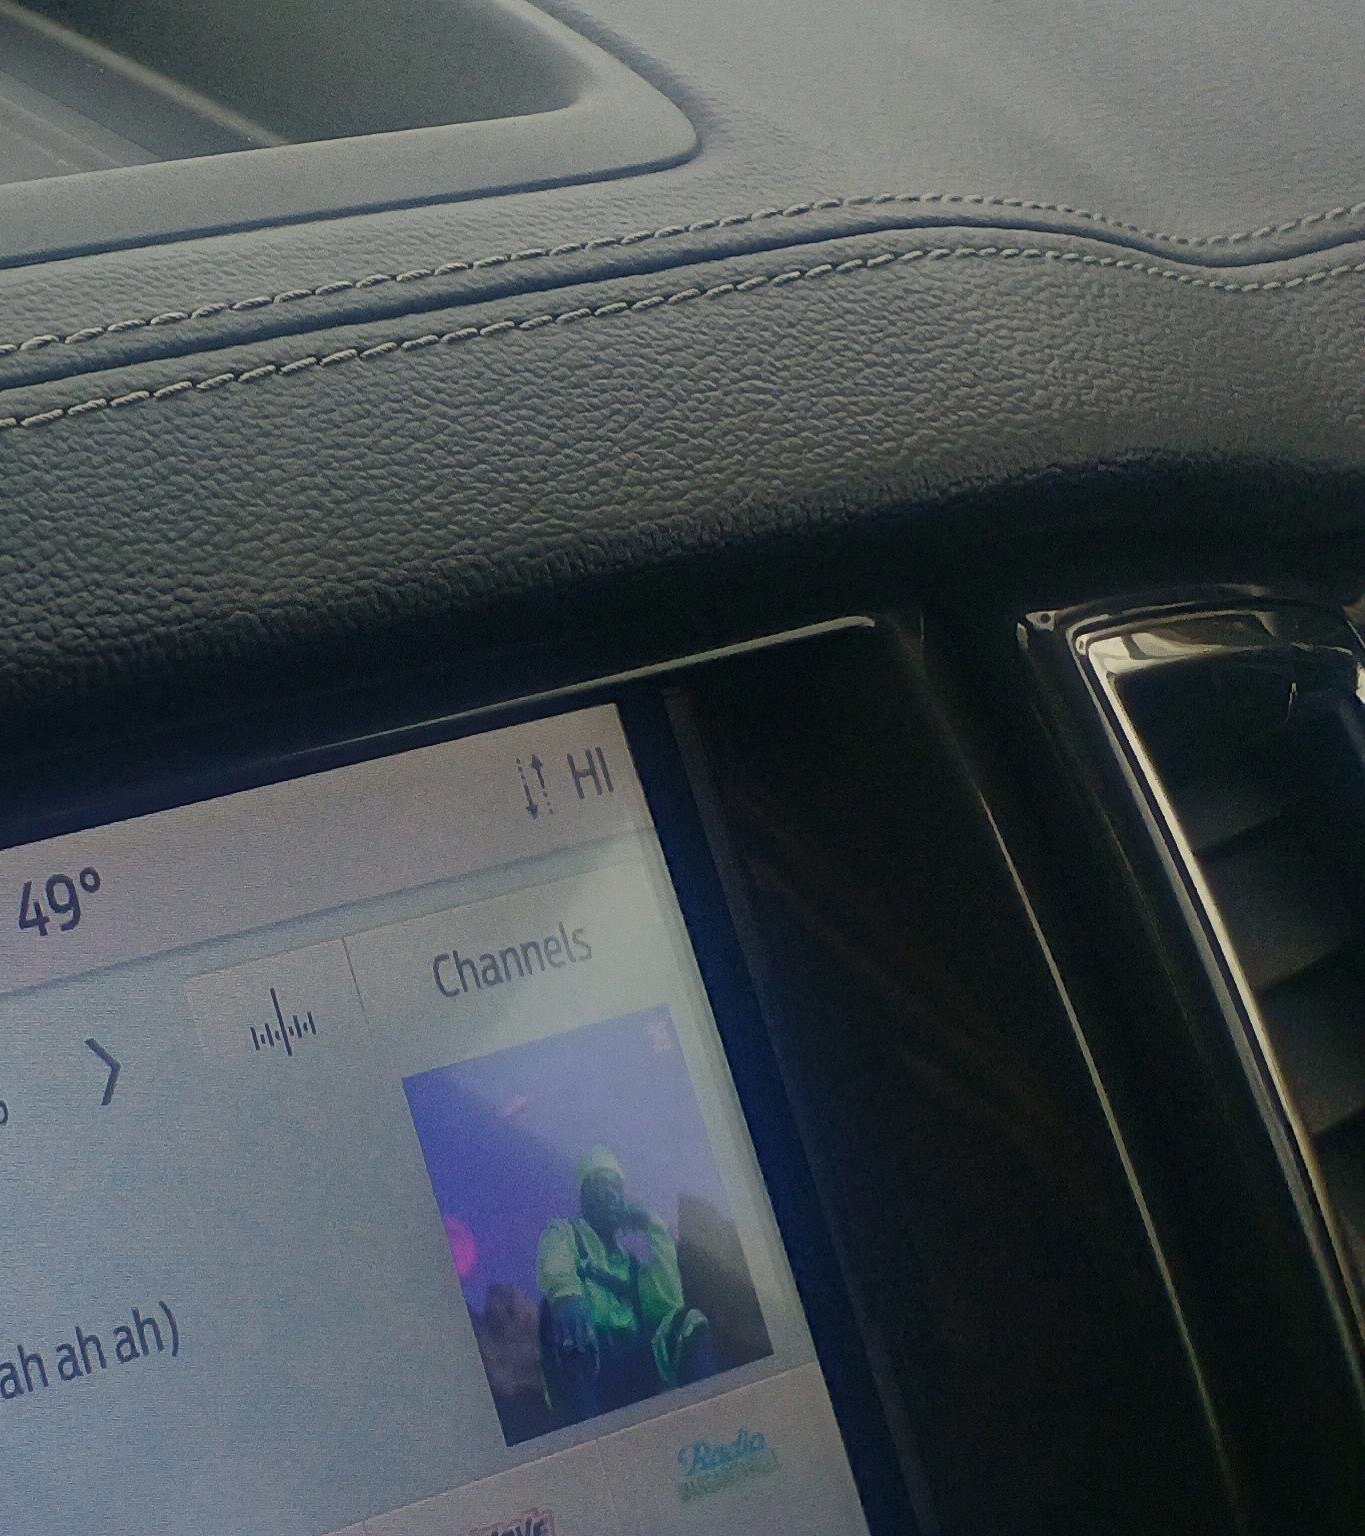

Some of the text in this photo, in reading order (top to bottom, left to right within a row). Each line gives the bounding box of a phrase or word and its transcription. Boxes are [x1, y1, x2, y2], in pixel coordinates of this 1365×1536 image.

[566, 746, 615, 800] HI
[18, 866, 102, 936] 49°
[432, 920, 594, 998] Channels
[56, 1324, 109, 1384] ah
[113, 1300, 181, 1360] ah)
